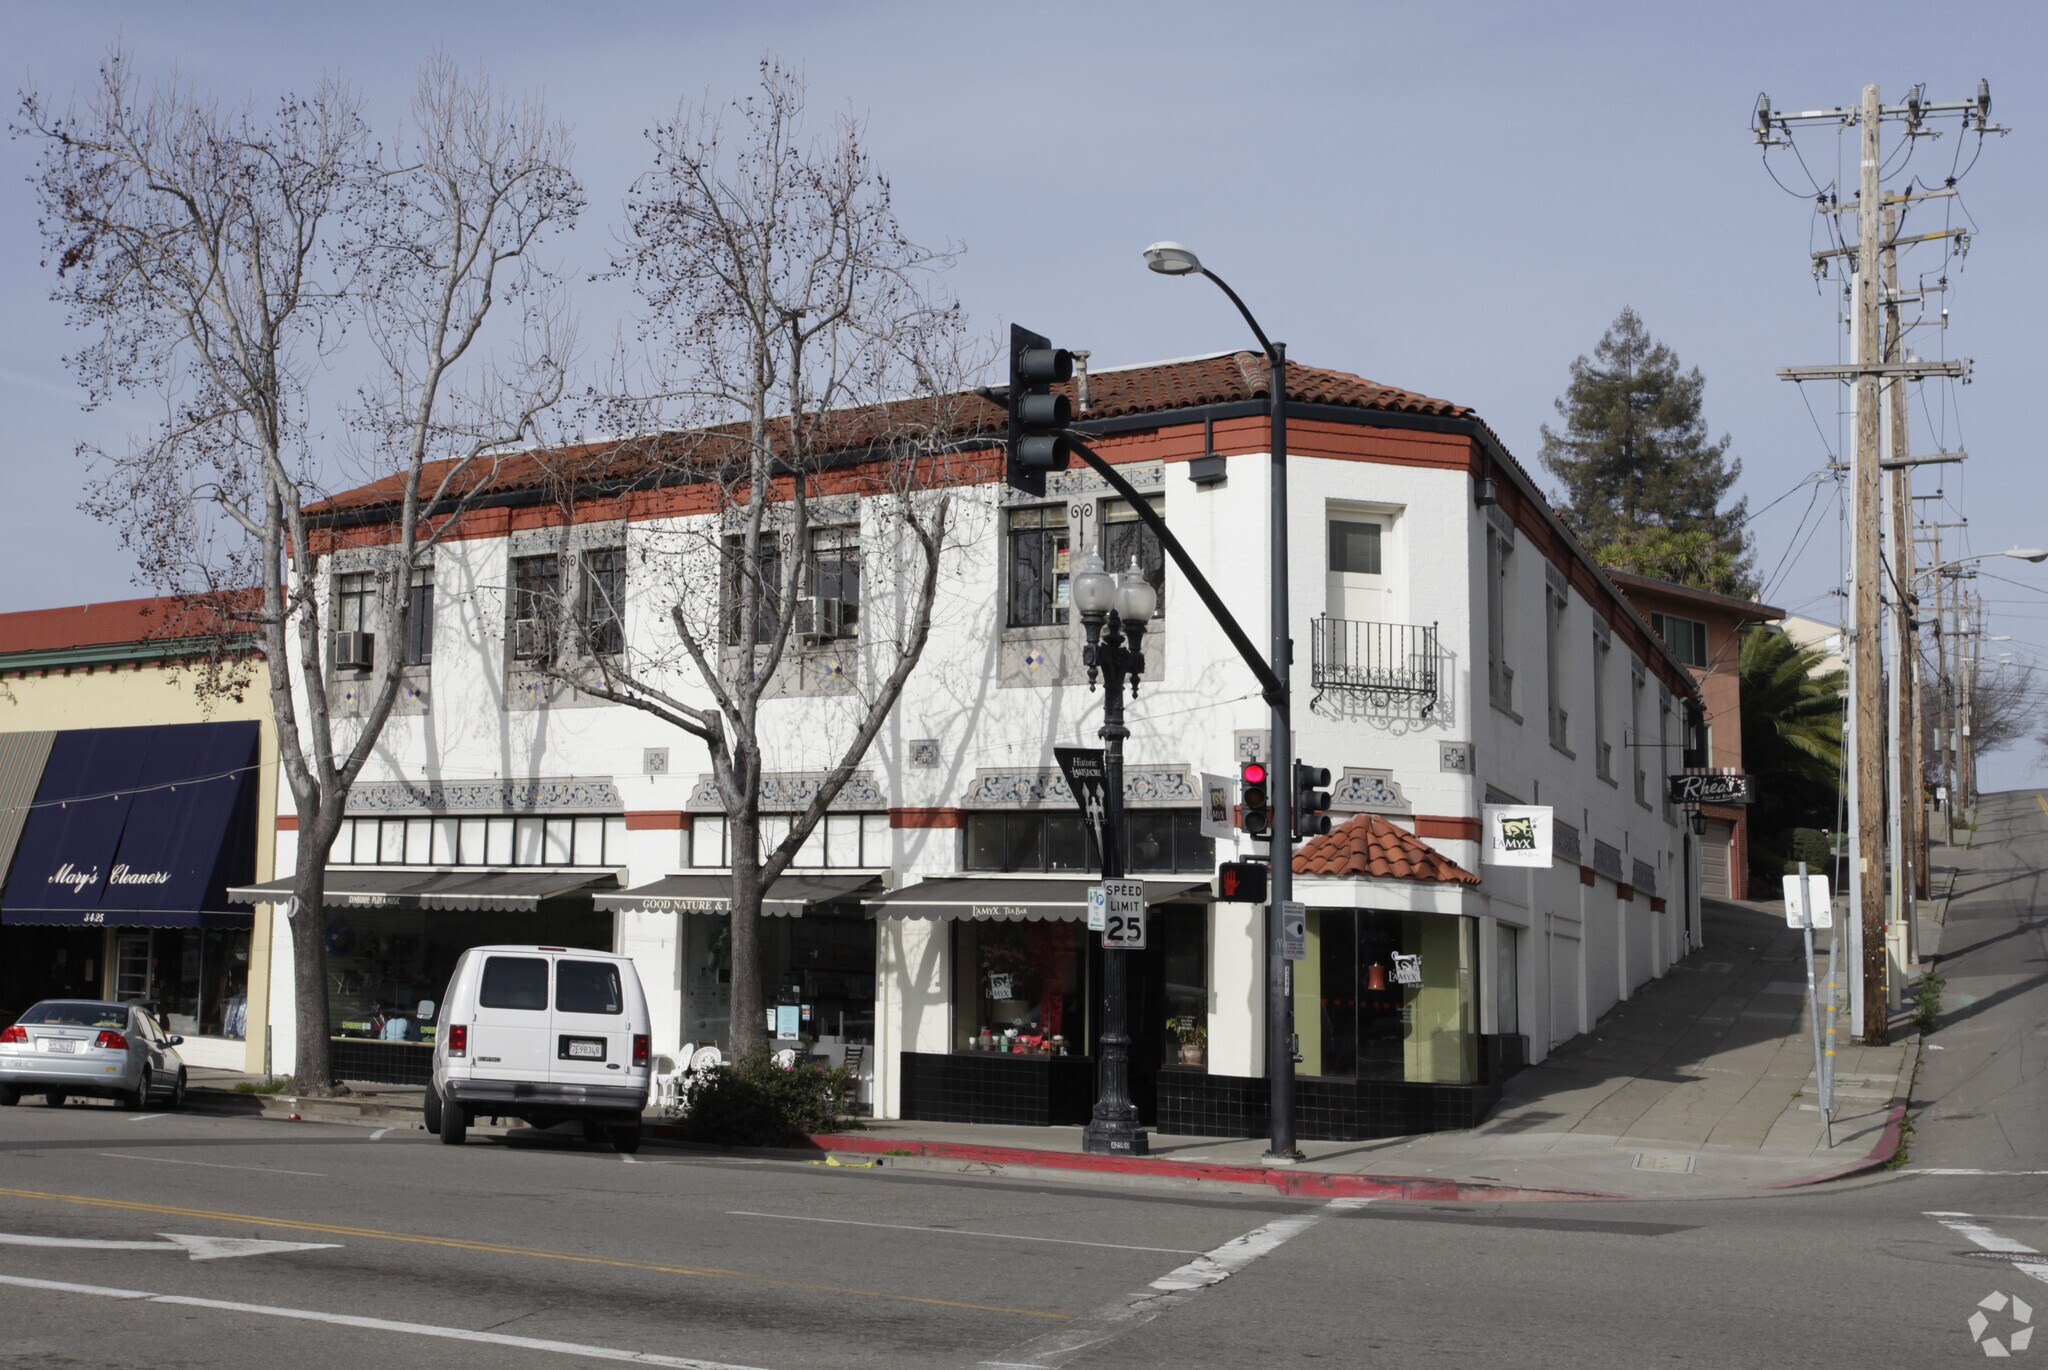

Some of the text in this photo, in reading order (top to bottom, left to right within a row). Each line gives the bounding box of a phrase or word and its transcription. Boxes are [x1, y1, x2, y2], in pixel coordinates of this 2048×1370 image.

[1073, 757, 1098, 767] Historic
[1678, 776, 1735, 798] Rhea's
[48, 863, 171, 893] Mary's Cleaners
[1106, 884, 1142, 896] SPEED
[643, 899, 671, 909] GOOD
[673, 900, 712, 910] NATURE
[715, 901, 723, 911] &
[1110, 901, 1140, 911] LIMIT
[84, 913, 104, 922] 3425
[1107, 916, 1142, 942] 25
